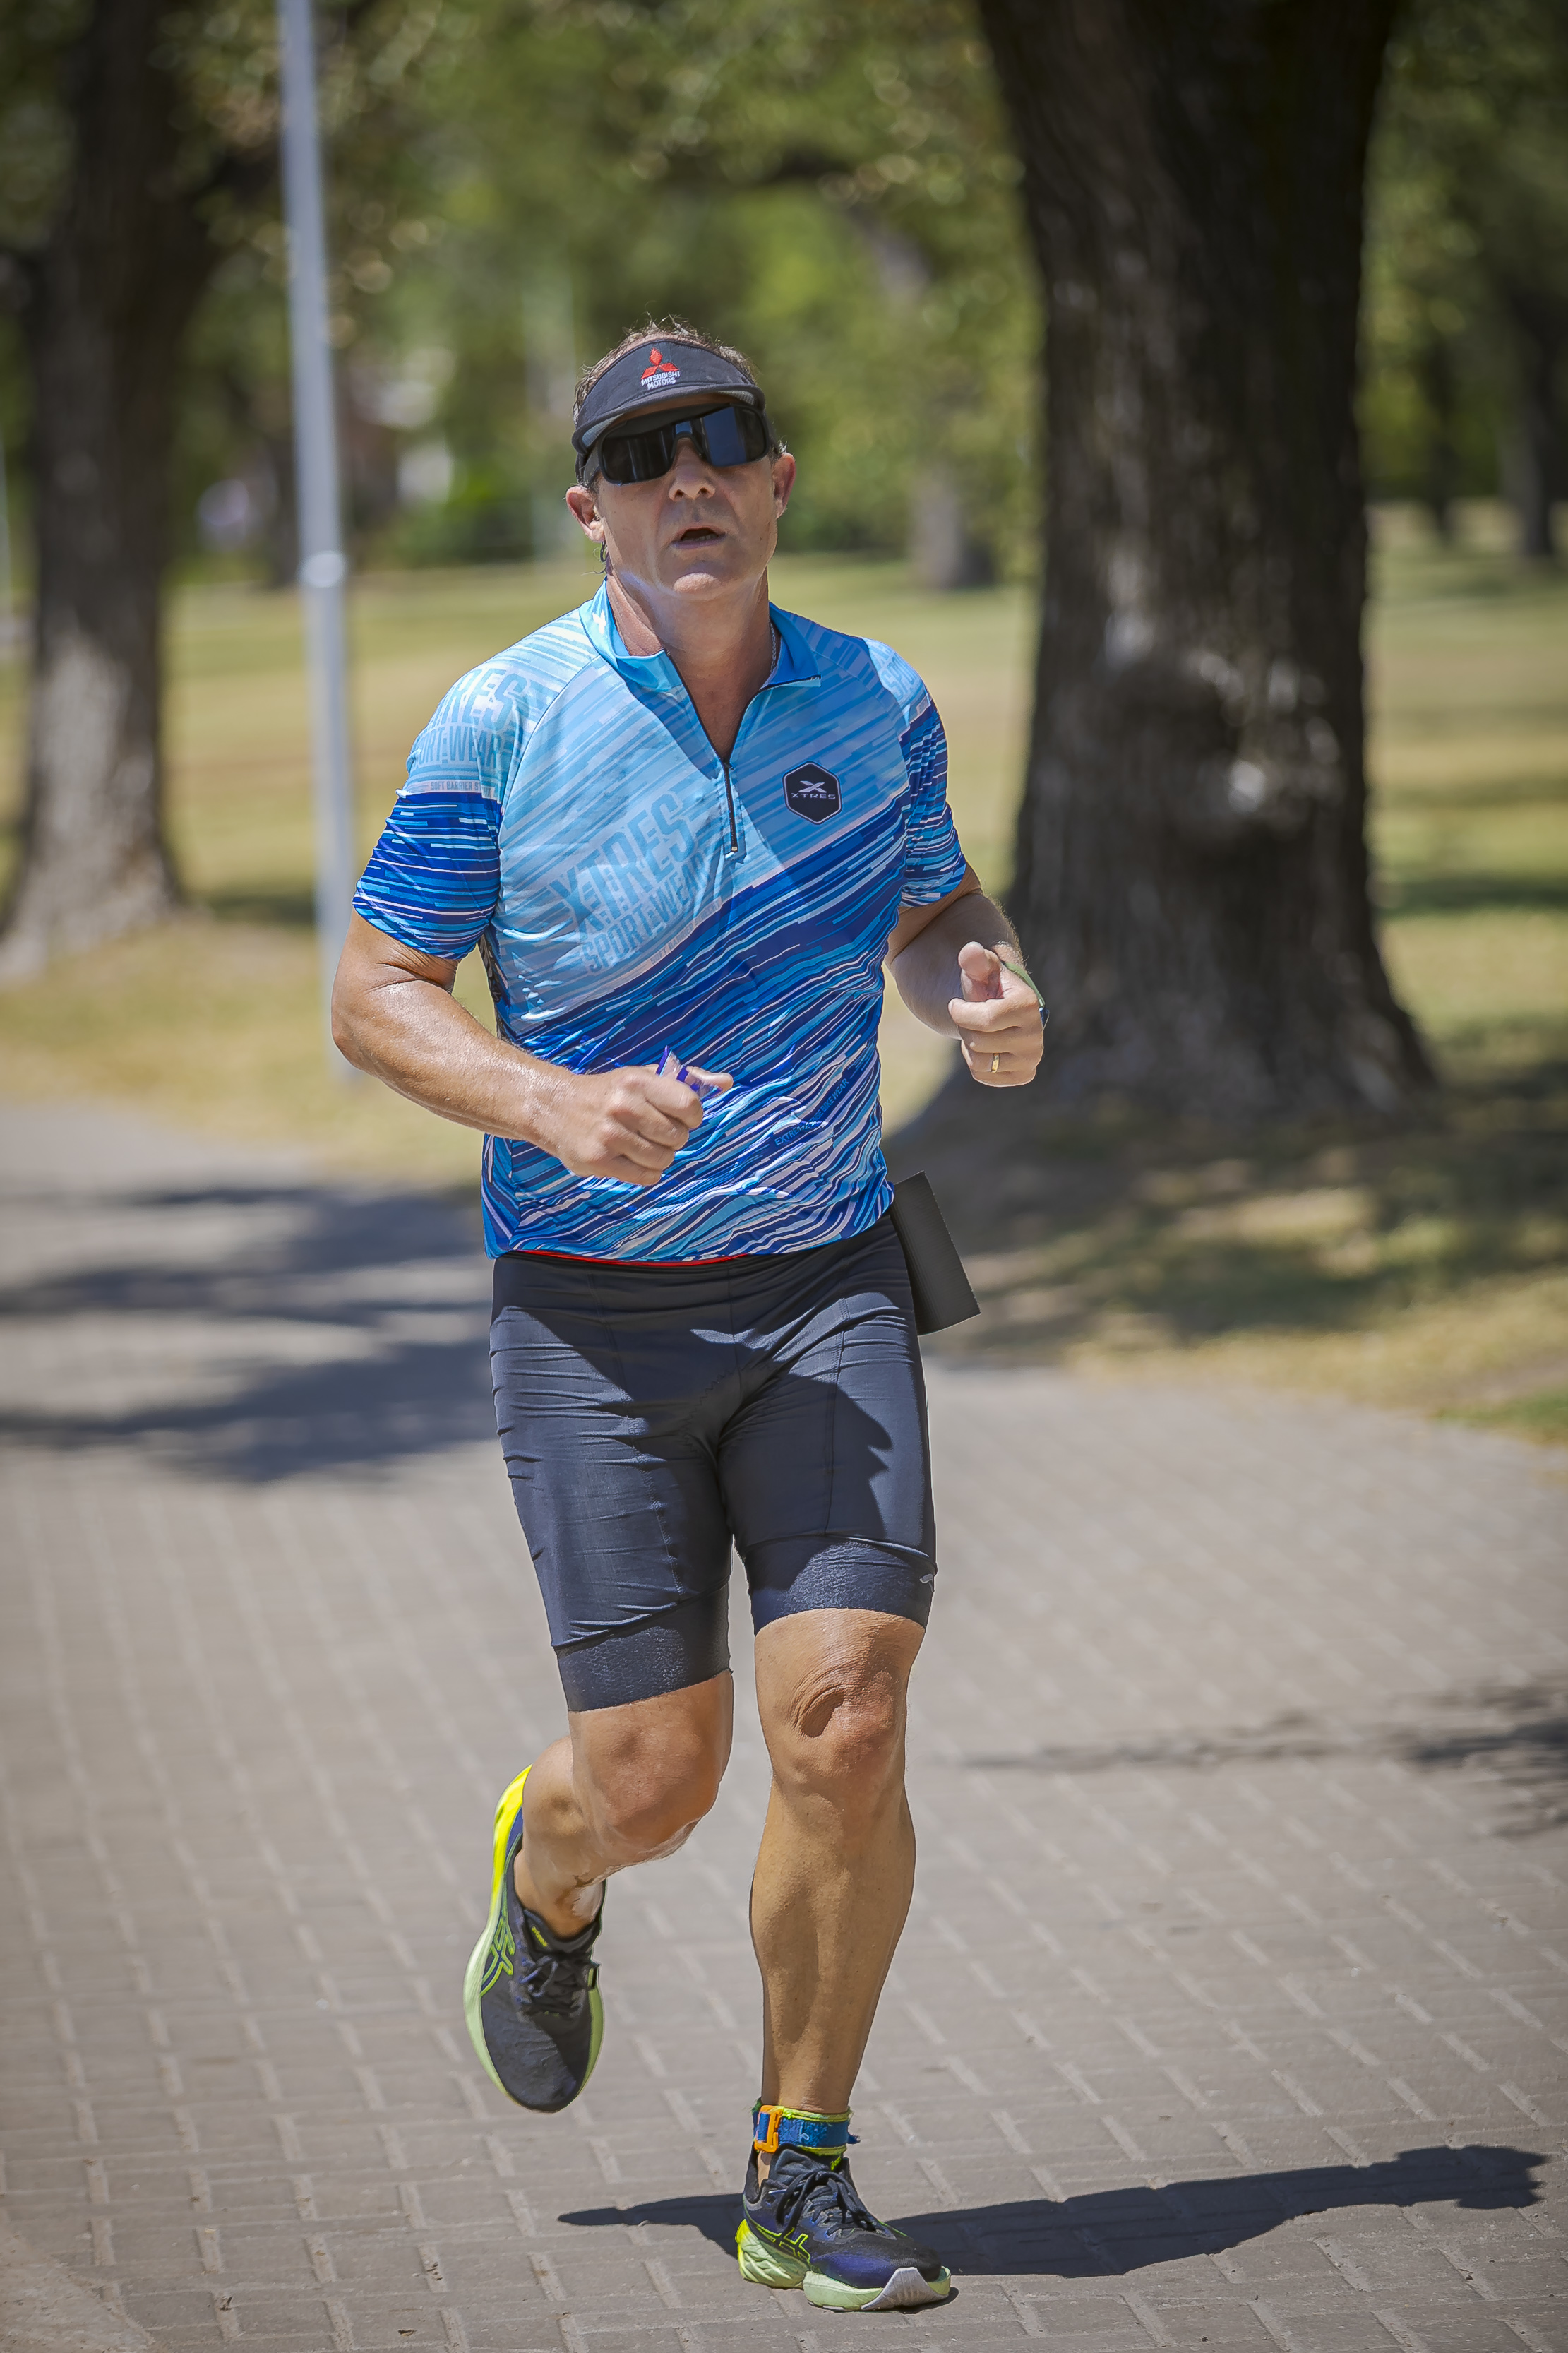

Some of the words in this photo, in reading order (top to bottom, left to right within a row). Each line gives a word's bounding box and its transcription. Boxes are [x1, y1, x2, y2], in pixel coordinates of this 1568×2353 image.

[640, 371, 681, 387] MITSUBISHI
[647, 376, 676, 391] MOTORS
[431, 781, 444, 790] SOFT
[446, 781, 473, 790] BARRIER
[549, 793, 695, 940] XTRES
[650, 946, 667, 965] SOFT
[668, 922, 694, 951] BARRIER
